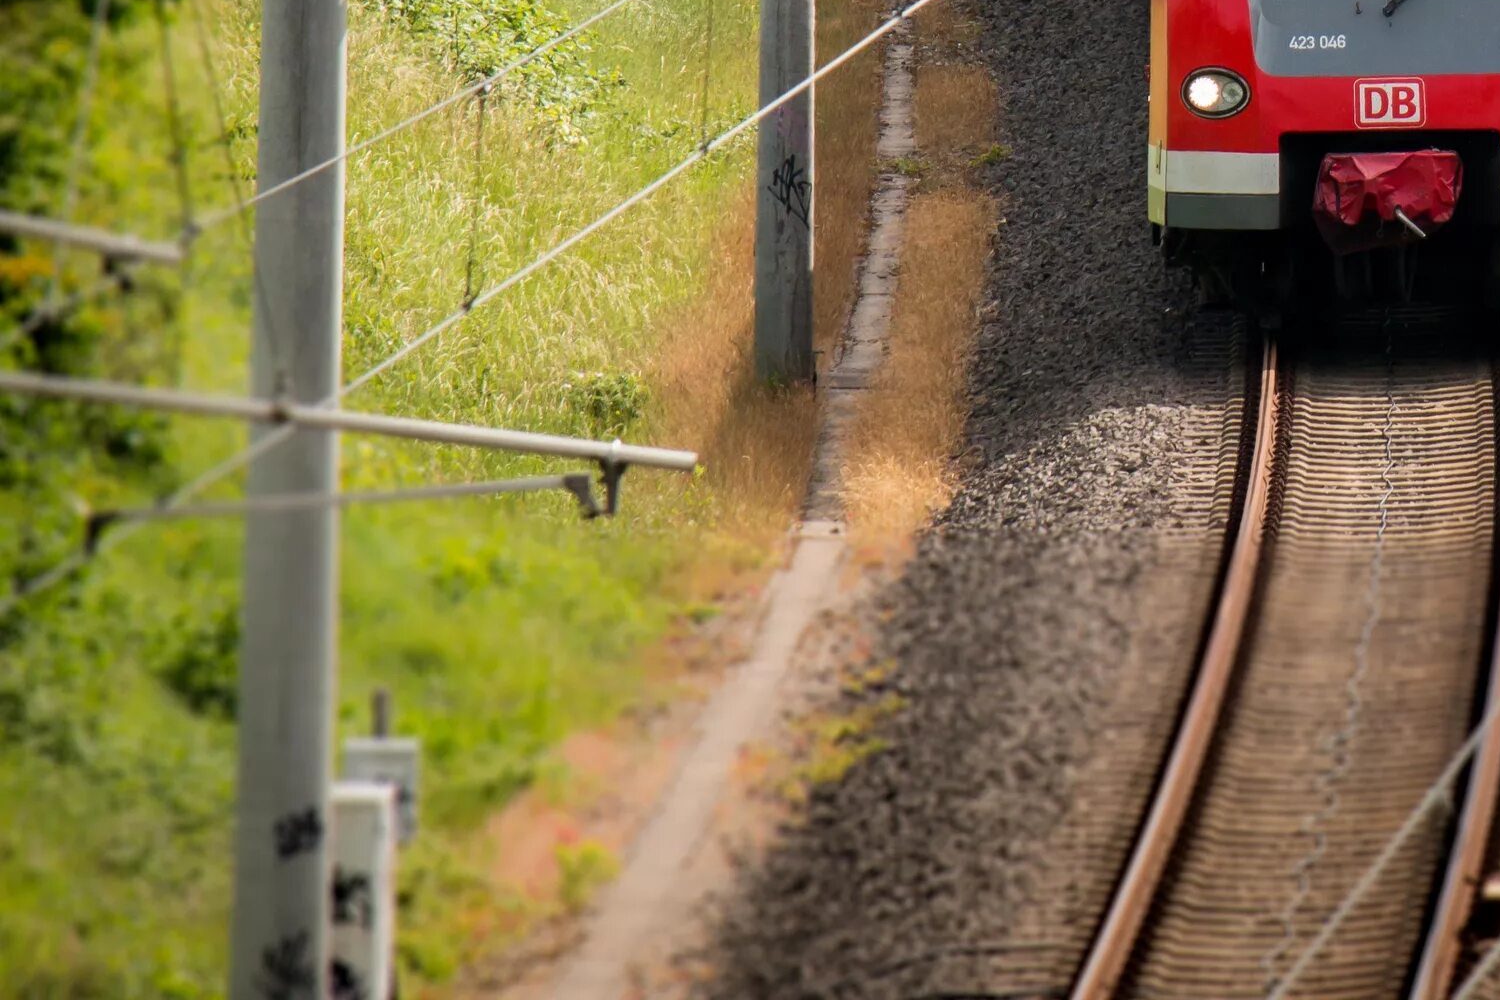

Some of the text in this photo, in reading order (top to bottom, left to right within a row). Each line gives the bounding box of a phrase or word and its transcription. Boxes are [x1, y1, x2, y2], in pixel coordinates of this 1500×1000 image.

[1289, 34, 1347, 49] 423 046
[1364, 86, 1417, 119] DB
